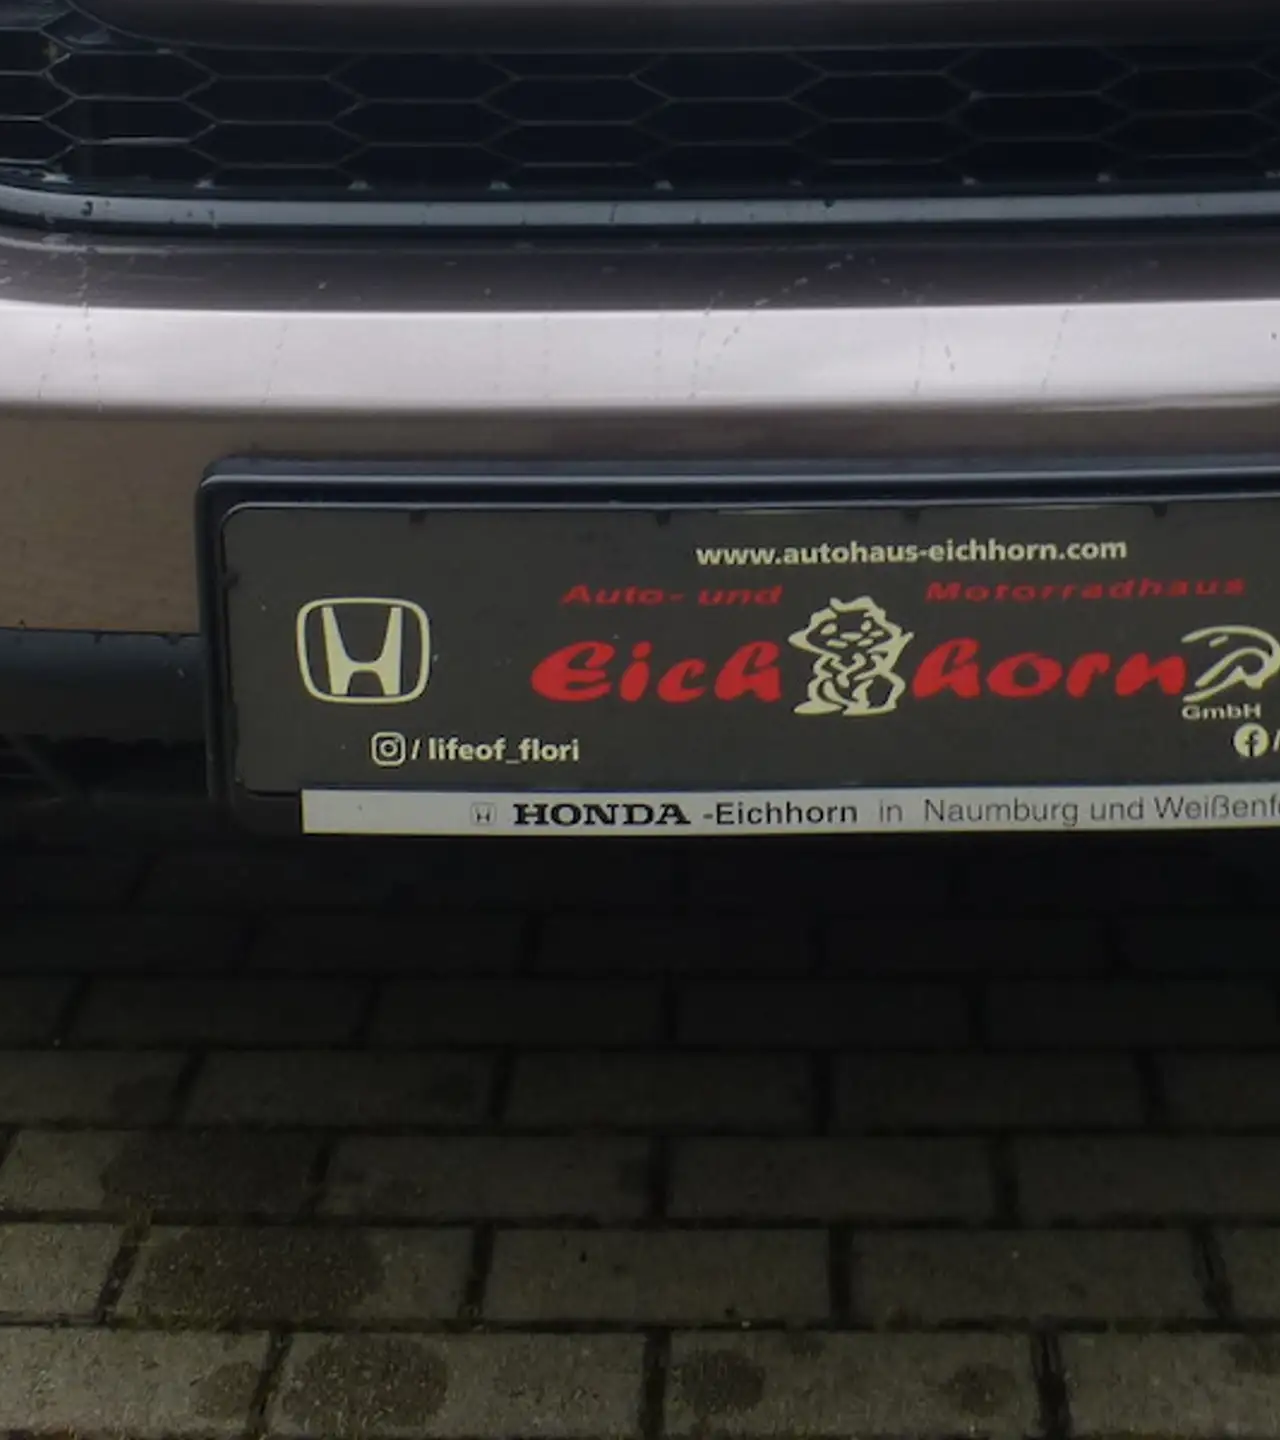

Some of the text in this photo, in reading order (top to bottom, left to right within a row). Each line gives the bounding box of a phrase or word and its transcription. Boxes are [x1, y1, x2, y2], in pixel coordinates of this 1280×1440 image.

[696, 539, 1128, 566] www.autohaus-eichhorn.com
[561, 577, 1247, 606] Auto- und Motorradhaus
[530, 637, 1186, 703] Eich horn
[1182, 704, 1262, 720] GmbH
[428, 737, 580, 764] lifeof_flori
[513, 803, 691, 826] HONDA
[879, 800, 903, 823] in
[924, 797, 1079, 827] Naumburg
[1089, 796, 1144, 822] und
